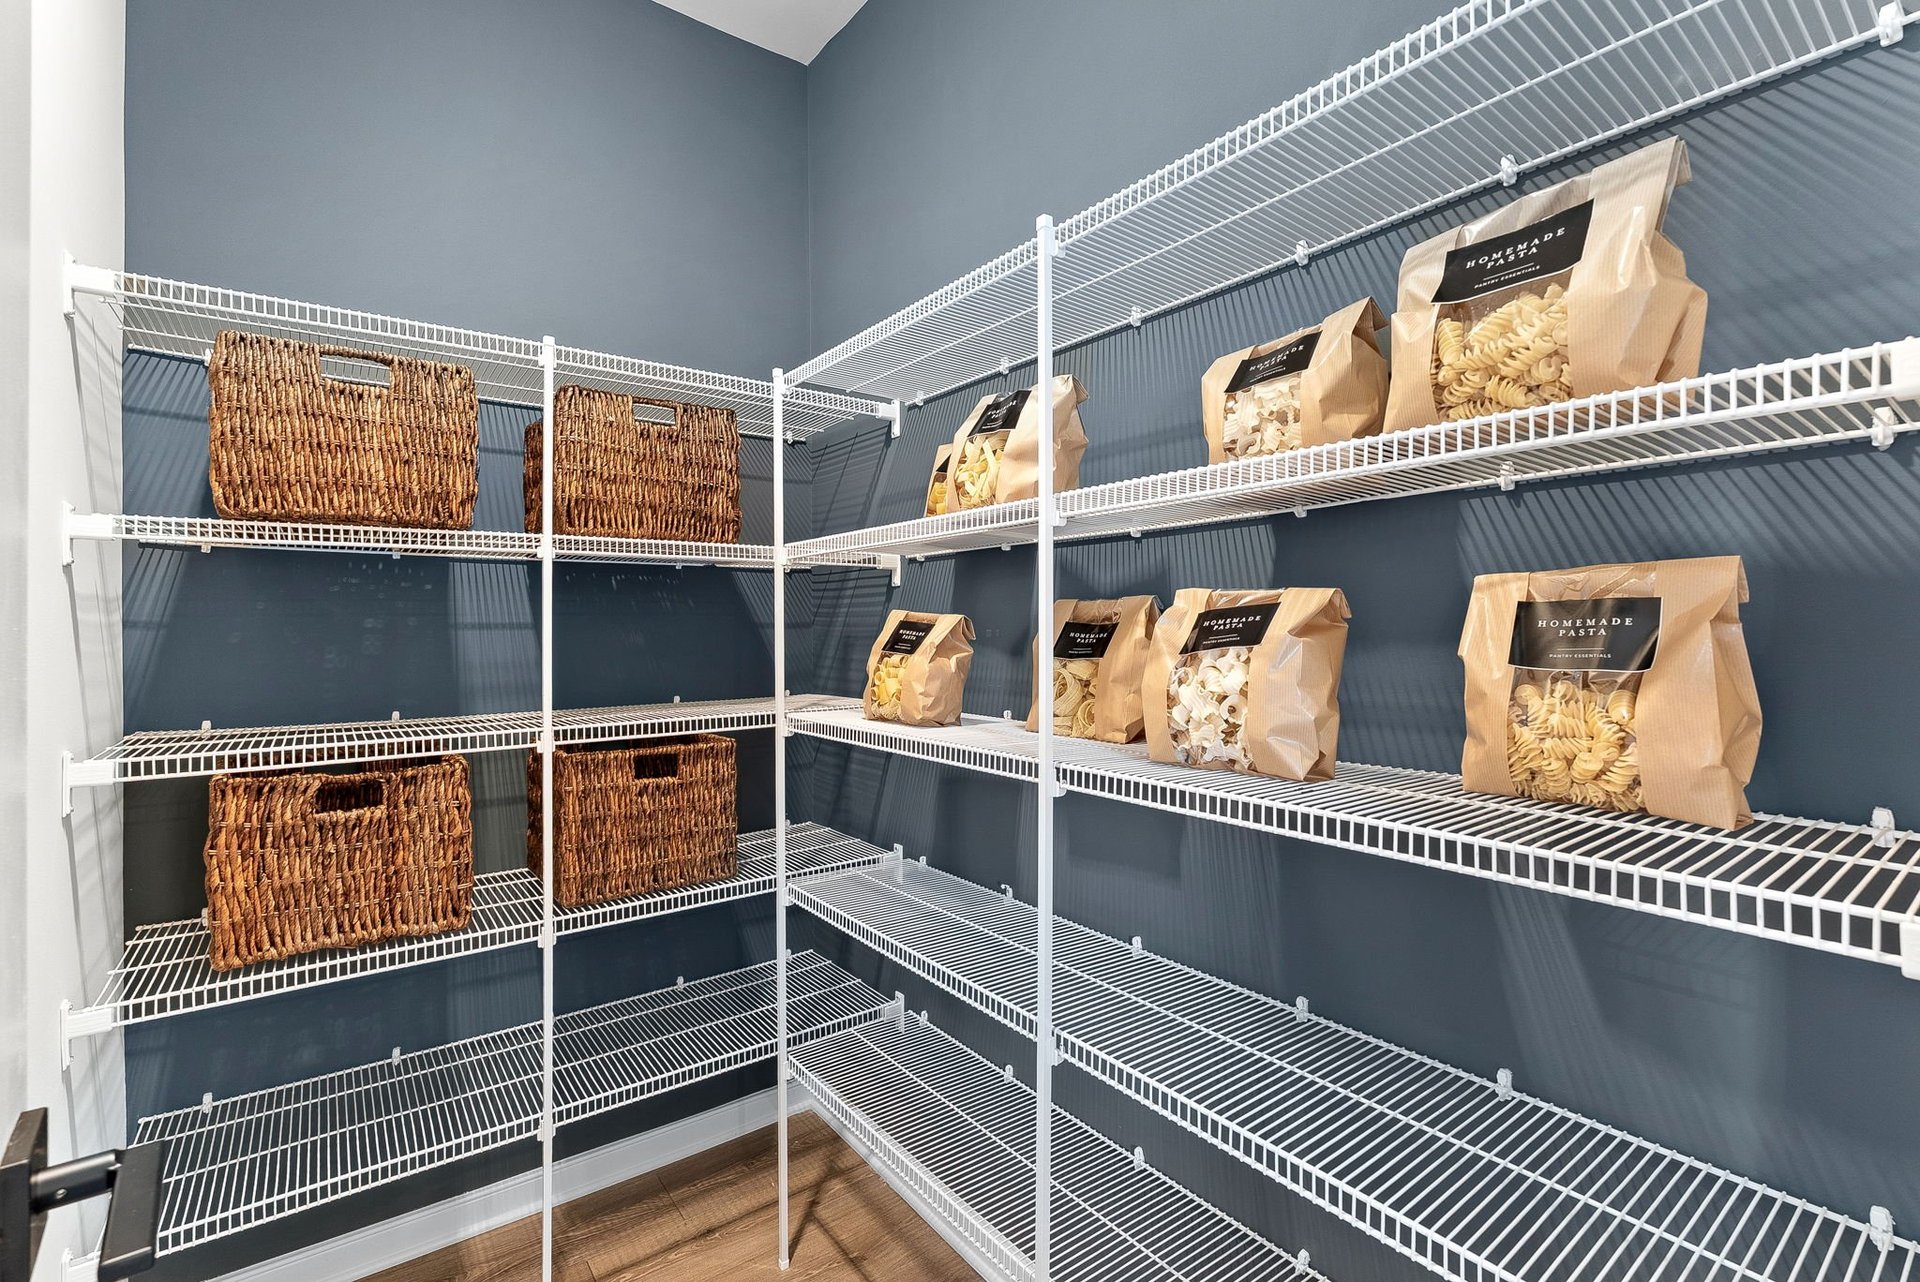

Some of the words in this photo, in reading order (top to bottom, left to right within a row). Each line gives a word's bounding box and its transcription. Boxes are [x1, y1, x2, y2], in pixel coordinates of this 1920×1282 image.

[1465, 227, 1566, 269] HOMEMADE
[1486, 247, 1538, 269] PASTA
[1474, 278, 1499, 289] PANTRY
[1500, 265, 1541, 281] ESSENTIALS
[1249, 345, 1304, 371] HOMEMADE
[1260, 355, 1287, 370] PASTA
[1203, 615, 1261, 627] HOMEMADE
[1213, 623, 1243, 631] PASTA
[1537, 617, 1634, 628] HOMEMADE
[1558, 628, 1607, 637] PASTA
